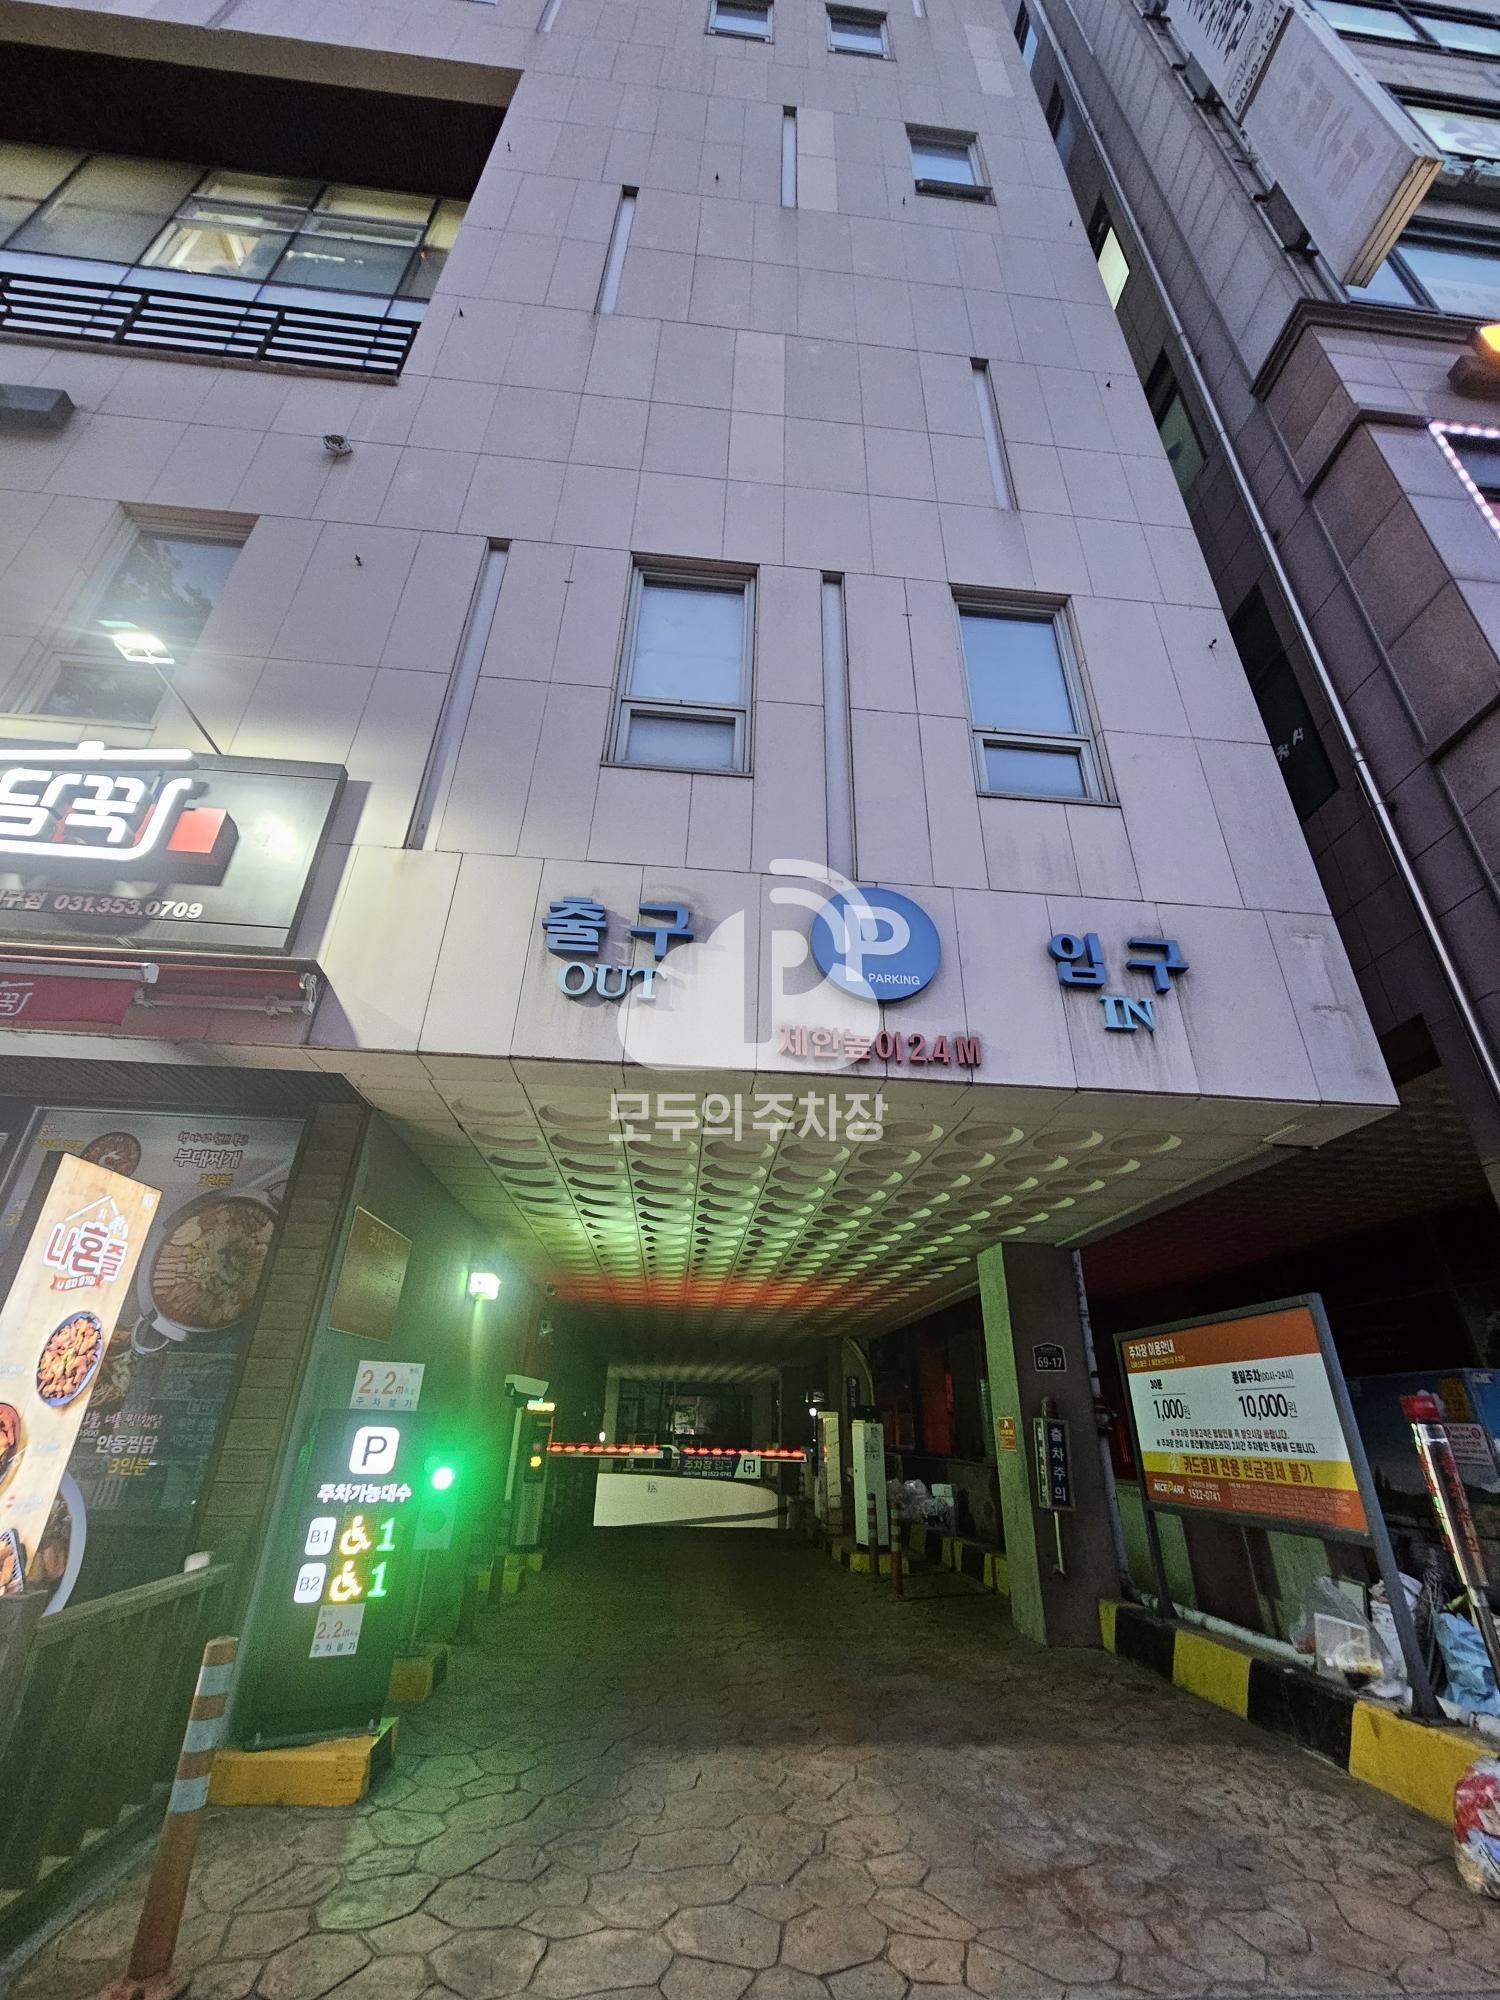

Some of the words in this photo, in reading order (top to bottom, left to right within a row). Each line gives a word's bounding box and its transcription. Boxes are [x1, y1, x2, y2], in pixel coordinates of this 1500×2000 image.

[54, 894, 204, 920] 031.353.0709
[843, 903, 911, 982] P
[557, 960, 669, 1002] OUT
[868, 972, 921, 986] PARKING
[1098, 994, 1155, 1032] IN
[173, 1147, 244, 1170] 부대찌개
[1037, 1356, 1063, 1369] 69-17
[1128, 1343, 1148, 1359] 주차장
[1148, 1339, 1176, 1357] 이용안내
[95, 1434, 159, 1454] 안동찜닭
[361, 1435, 388, 1467] P
[107, 1456, 151, 1477] 3인분
[1050, 1426, 1067, 1502] 출차주의
[1183, 1455, 1218, 1475] 카드결제
[1219, 1457, 1241, 1478] 전용
[1241, 1458, 1287, 1481] 현금결제
[1287, 1461, 1314, 1484] 불가
[316, 1482, 413, 1504] 주차가능대수
[309, 1529, 330, 1544] B1
[375, 1517, 396, 1552] 1
[298, 1575, 321, 1592] B2
[366, 1561, 388, 1598] 1
